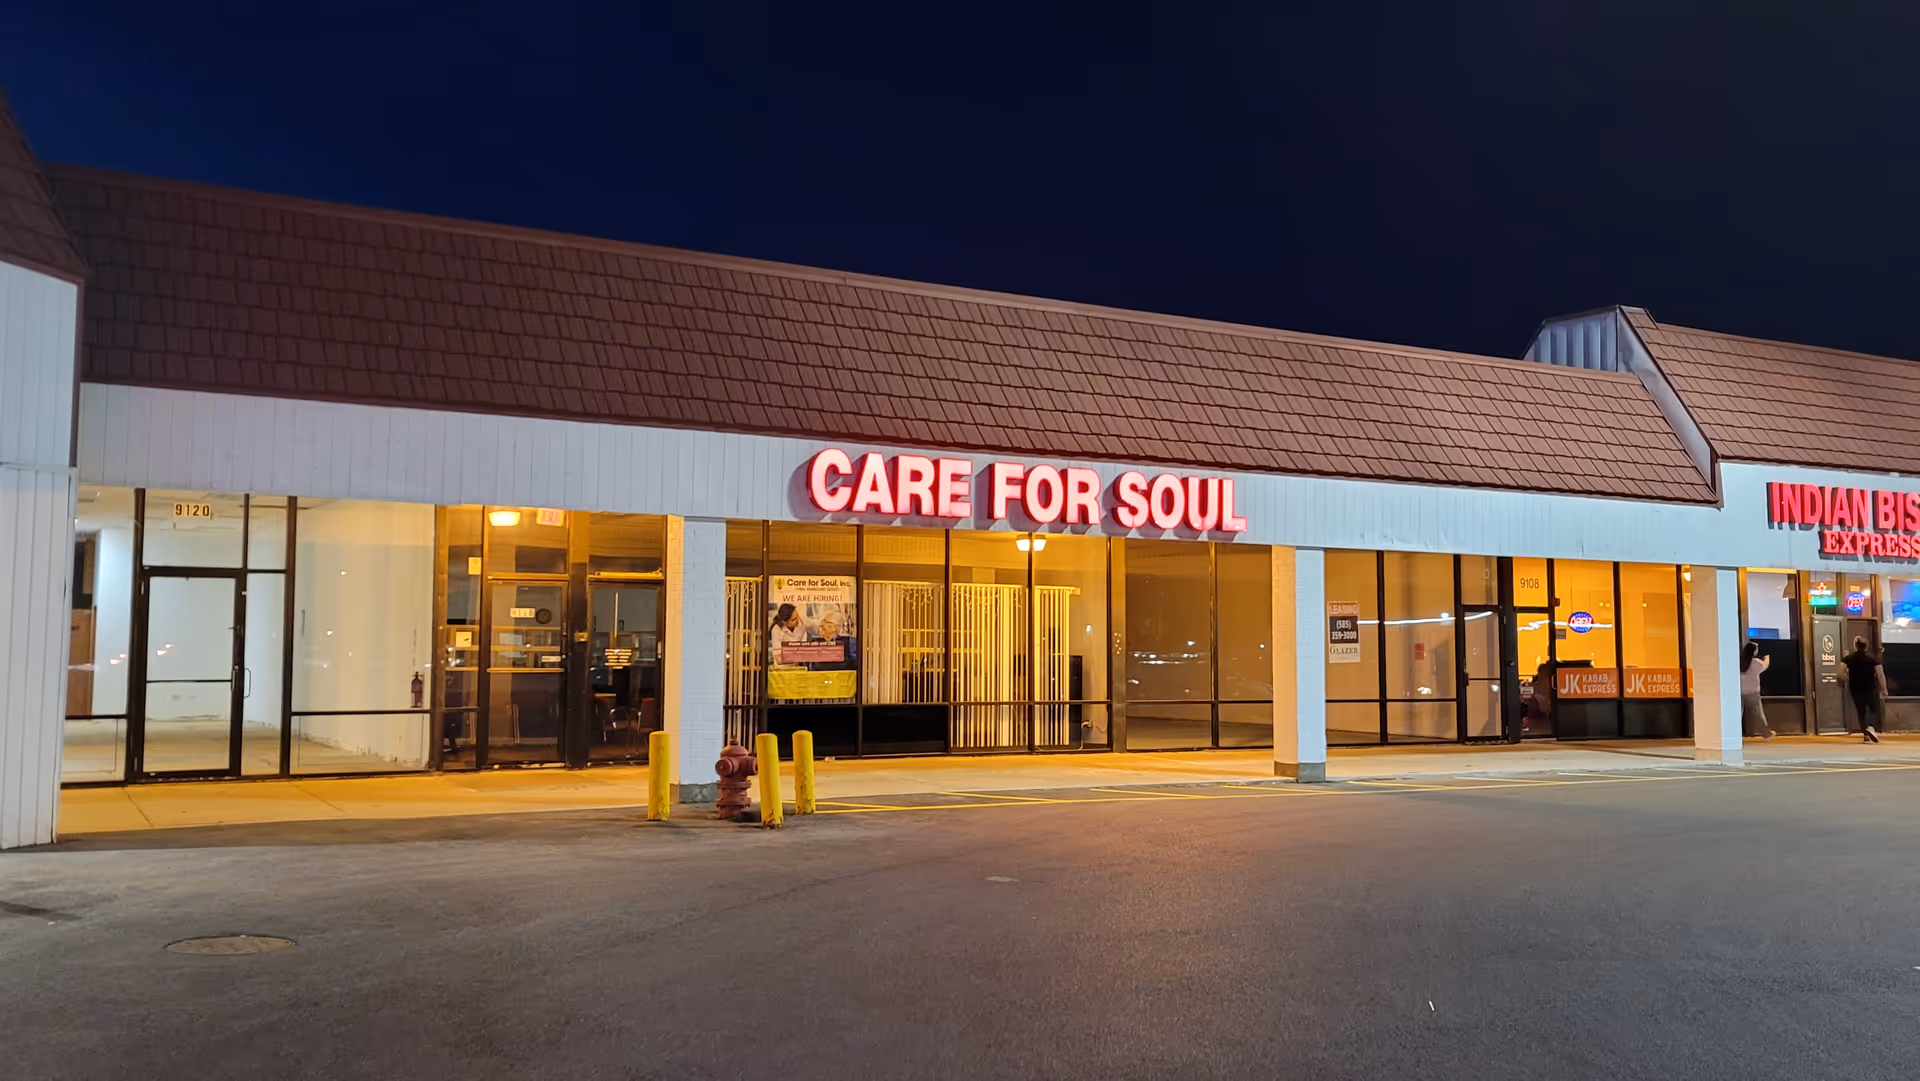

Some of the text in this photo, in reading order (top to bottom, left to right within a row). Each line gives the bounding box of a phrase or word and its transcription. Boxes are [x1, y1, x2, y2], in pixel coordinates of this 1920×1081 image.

[810, 448, 1248, 532] CARE FOR SOUL
[175, 503, 210, 517] 9120
[1769, 481, 1920, 532] INDIAN BIS
[1823, 530, 1920, 559] EXPRESS
[787, 578, 807, 587] Care
[808, 578, 819, 587] for
[1520, 577, 1540, 589] 9108
[783, 594, 843, 602] WE ARE HIRING!
[1847, 596, 1865, 608] OPEN
[1336, 619, 1352, 630] (585)
[1569, 616, 1593, 628] OPEN
[1330, 645, 1358, 655] GLAZER
[1560, 673, 1581, 694] JK
[1582, 673, 1608, 683] KABAB
[1626, 673, 1646, 694] JK
[1647, 673, 1672, 683] KABAB
[1583, 684, 1617, 694] EXPRESS
[1648, 684, 1680, 694] EXPRESS
